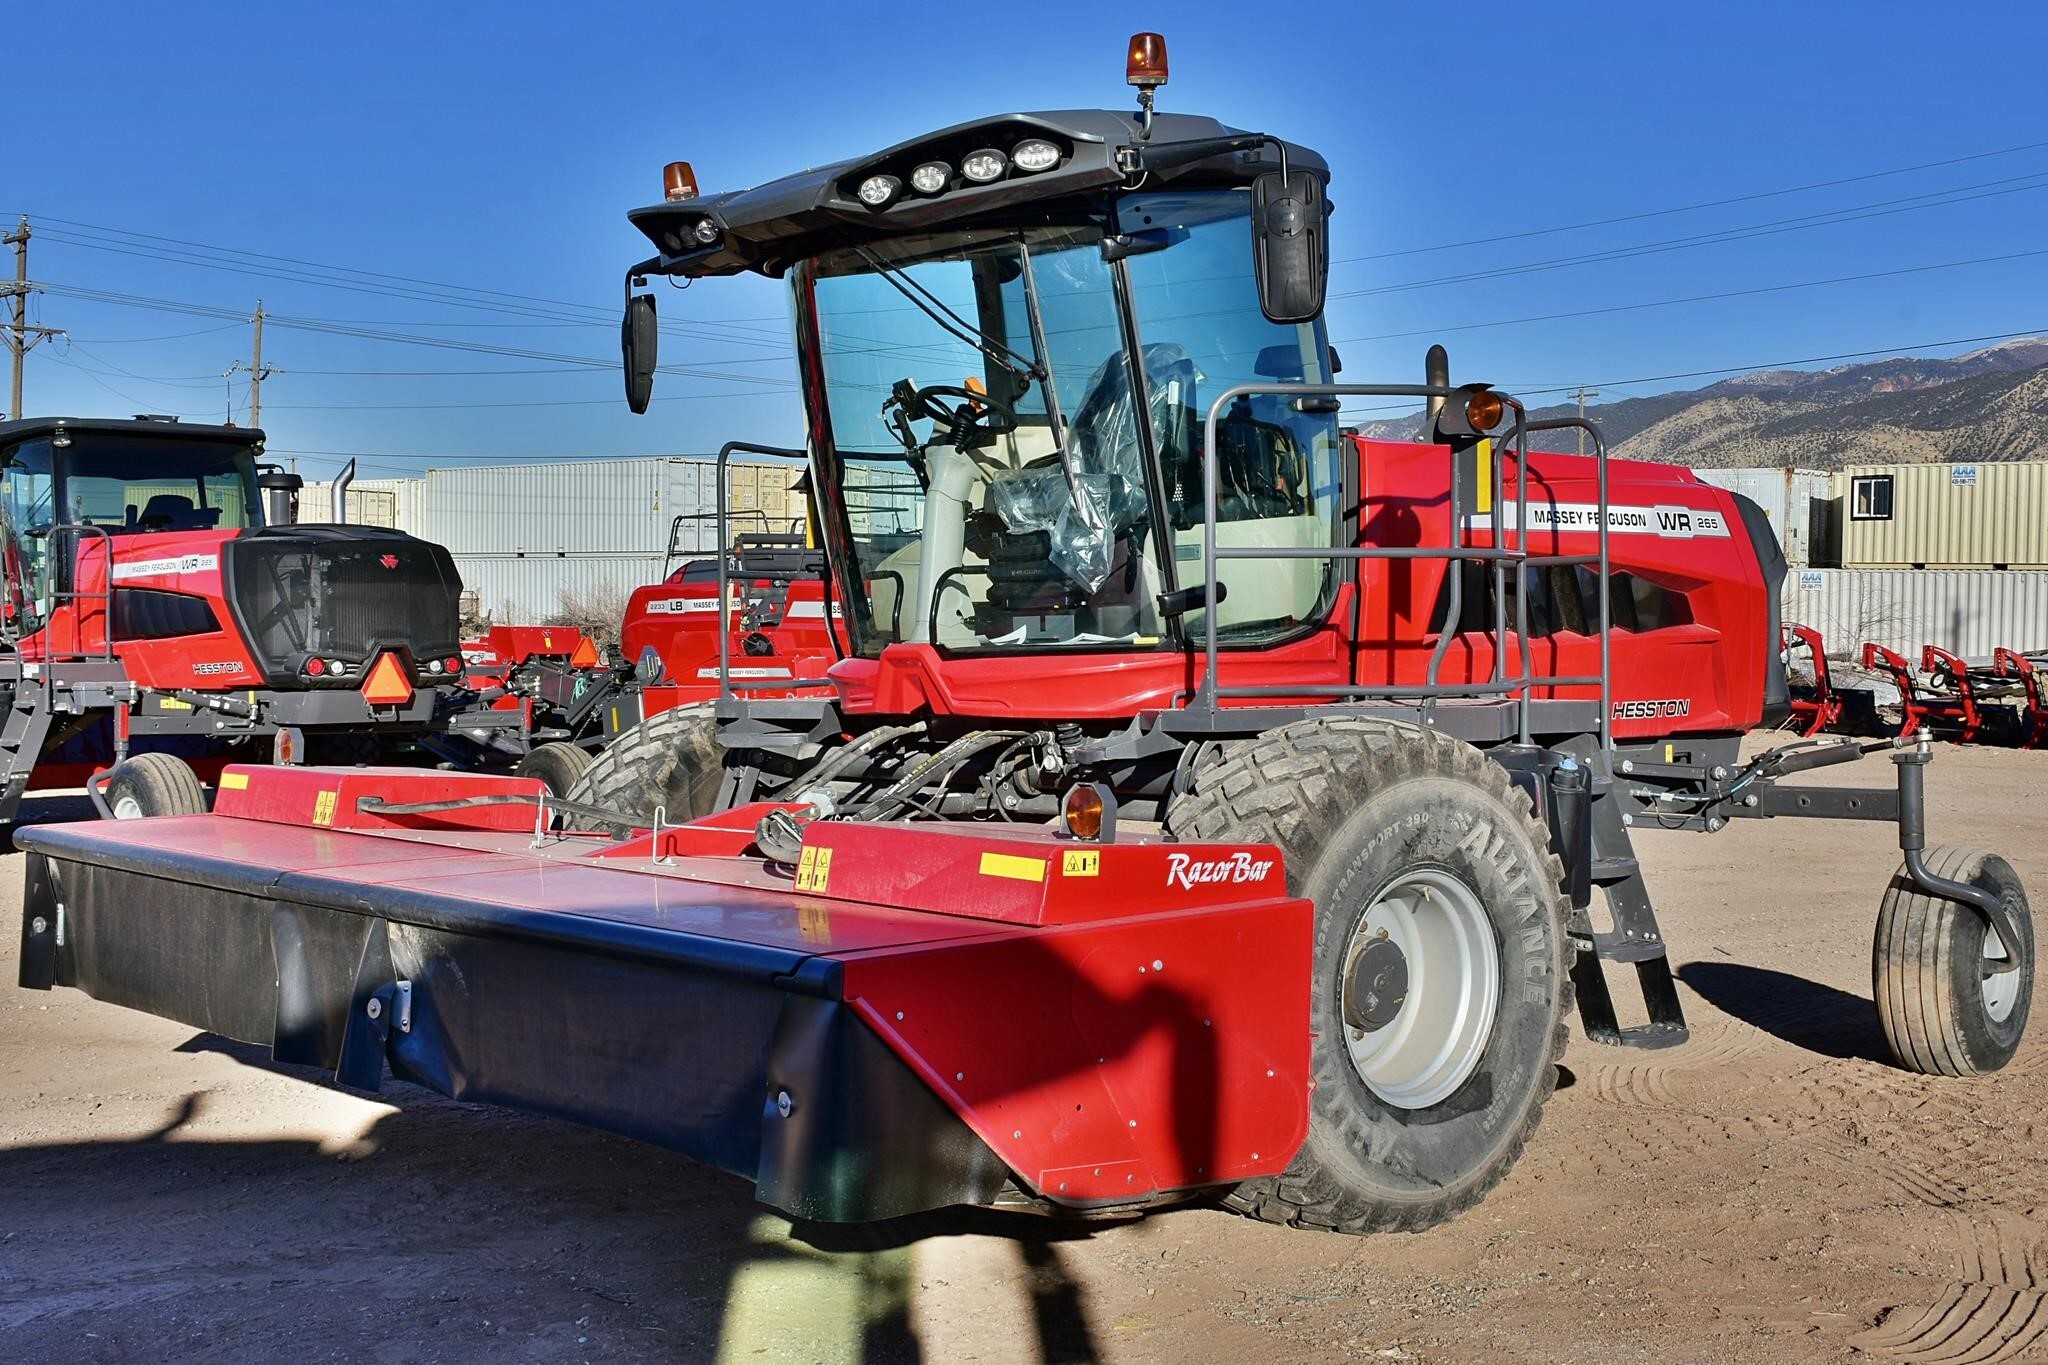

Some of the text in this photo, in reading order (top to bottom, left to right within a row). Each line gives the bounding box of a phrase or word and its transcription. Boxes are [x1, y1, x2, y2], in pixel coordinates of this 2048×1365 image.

[1534, 509, 1719, 532] MASSEY FEGUSON WR 265
[181, 558, 199, 570] WR
[669, 601, 683, 611] LB
[693, 601, 715, 610] MASSEY
[192, 661, 244, 675] HESSTON
[1612, 699, 1690, 719] HESSTON
[1405, 811, 1430, 828] 390
[1456, 820, 1549, 1005] ALLIANCE
